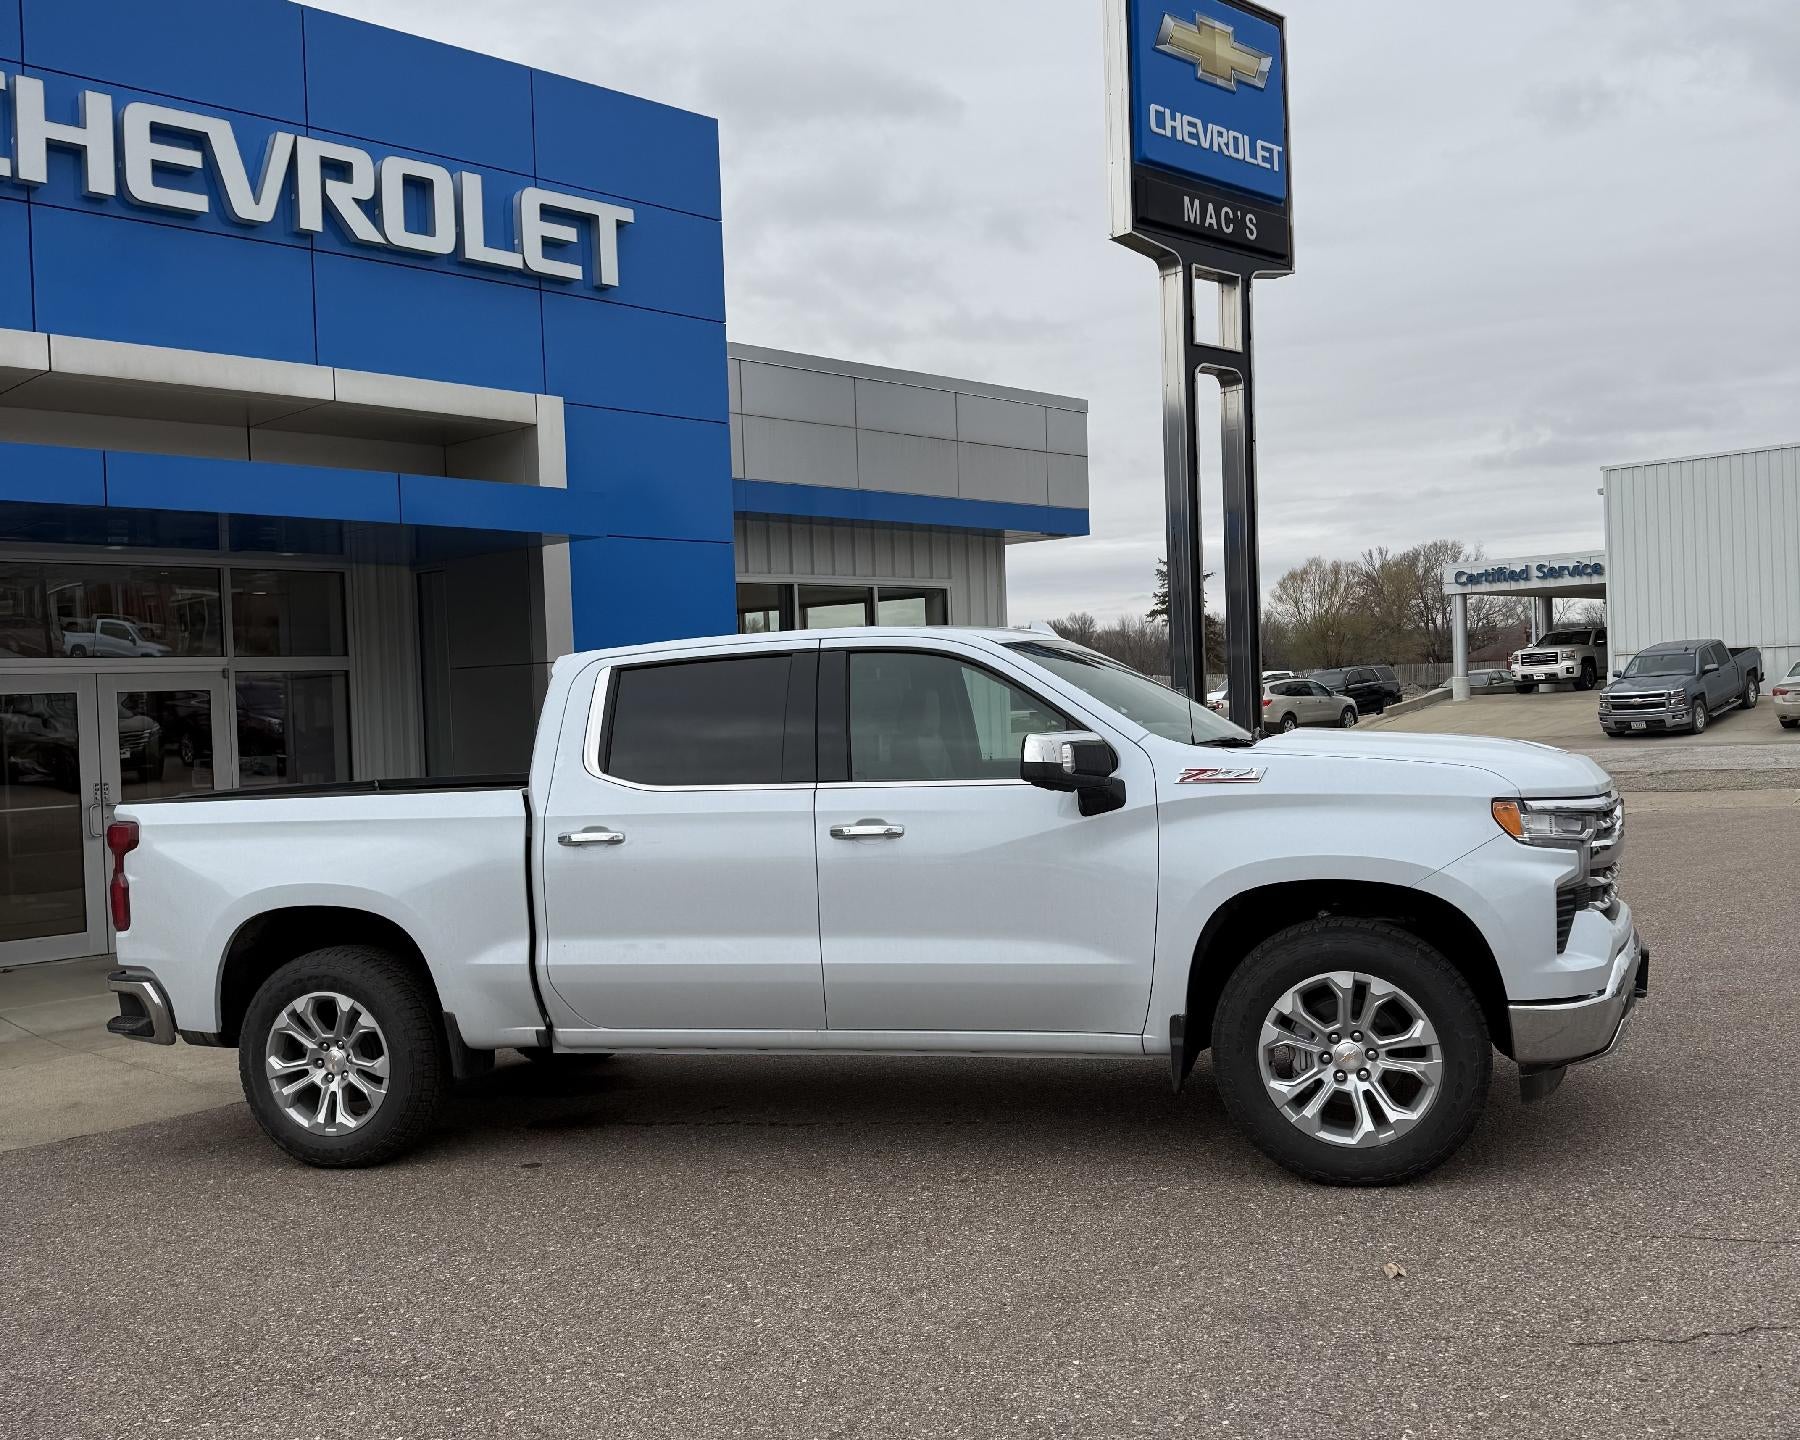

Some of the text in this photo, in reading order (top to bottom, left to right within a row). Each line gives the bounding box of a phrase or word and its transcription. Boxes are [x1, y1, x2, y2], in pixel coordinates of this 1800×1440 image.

[1149, 103, 1283, 172] CHEVROLET
[0, 70, 635, 288] HEVROLET
[1183, 195, 1258, 241] MAC'S
[1454, 560, 1603, 586] Certified Service
